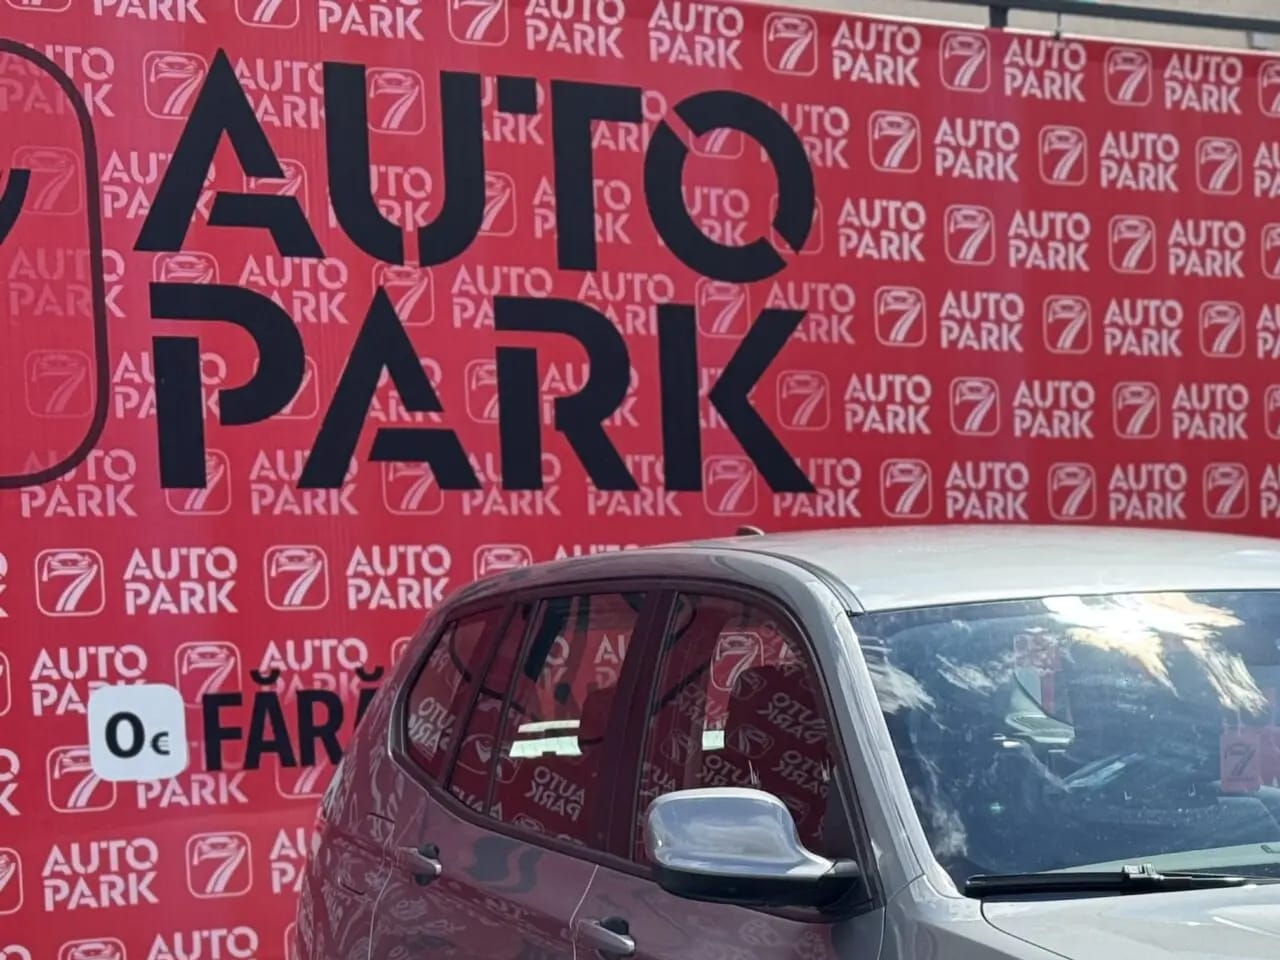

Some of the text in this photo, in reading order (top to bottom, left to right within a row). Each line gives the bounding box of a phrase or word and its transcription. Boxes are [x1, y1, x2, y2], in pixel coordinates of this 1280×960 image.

[319, 4, 423, 40] PARK
[525, 0, 624, 25] AUTO
[648, 0, 743, 37] AUTO
[526, 18, 628, 58] PARK
[649, 30, 741, 69] PARK
[832, 22, 920, 56] AUTO
[1004, 36, 1085, 72] AUTO
[2, 44, 115, 80] ATO
[833, 49, 919, 87] PARK
[1164, 55, 1241, 84] AUTO
[0, 80, 115, 118] PAK
[1004, 66, 1085, 101] PARK
[1165, 80, 1241, 114] PARK
[246, 95, 324, 129] ARK
[779, 102, 849, 137] UTO
[934, 118, 1019, 152] AUTO
[1100, 131, 1179, 162] AUTO
[102, 150, 216, 184] AU
[133, 47, 815, 284] AUTO
[936, 147, 1018, 182] PARK
[1101, 159, 1178, 192] PARK
[370, 164, 432, 199] TO
[681, 186, 749, 218] UTO
[838, 198, 926, 231] AUTO
[1008, 210, 1090, 241] AUTO
[1168, 220, 1245, 250] AUTO
[836, 228, 924, 261] PARK
[1009, 235, 1089, 271] PARK
[1168, 245, 1244, 277] PARK
[238, 255, 348, 292] AUTO
[451, 264, 552, 297] AUTO
[578, 272, 674, 303] AUTO
[453, 299, 494, 328] PA
[765, 281, 855, 313] AUTO
[940, 291, 1024, 322] AUTO
[1104, 299, 1183, 328] AUTO
[941, 319, 1023, 352] PARK
[1105, 327, 1181, 356] PARK
[112, 352, 227, 384] AUO
[148, 282, 818, 494] PARK
[845, 374, 931, 404] AUTO
[1013, 380, 1094, 409] AUTO
[1172, 384, 1249, 411] AUTO
[846, 403, 930, 434] PARK
[1014, 409, 1093, 438] PARK
[1173, 411, 1248, 439] PARK
[468, 453, 561, 484] AUO
[805, 458, 861, 487] TO
[946, 462, 1029, 490] AUTO
[1109, 463, 1187, 491] AUTO
[21, 484, 137, 517] PARK
[251, 483, 358, 519] PARK
[462, 489, 560, 515] PARK
[588, 490, 681, 516] PARK
[774, 488, 861, 517] PARK
[947, 490, 1028, 520] PARK
[1109, 492, 1185, 520] PARK
[124, 547, 237, 580] AUTO
[346, 545, 451, 576] AUTO
[126, 581, 237, 614] PARK
[348, 577, 449, 610] PARK
[30, 645, 147, 680] AUTO
[260, 638, 368, 672] AUTO
[136, 773, 248, 809] PARK
[42, 838, 158, 877] AUTO
[44, 872, 158, 911] PARK
